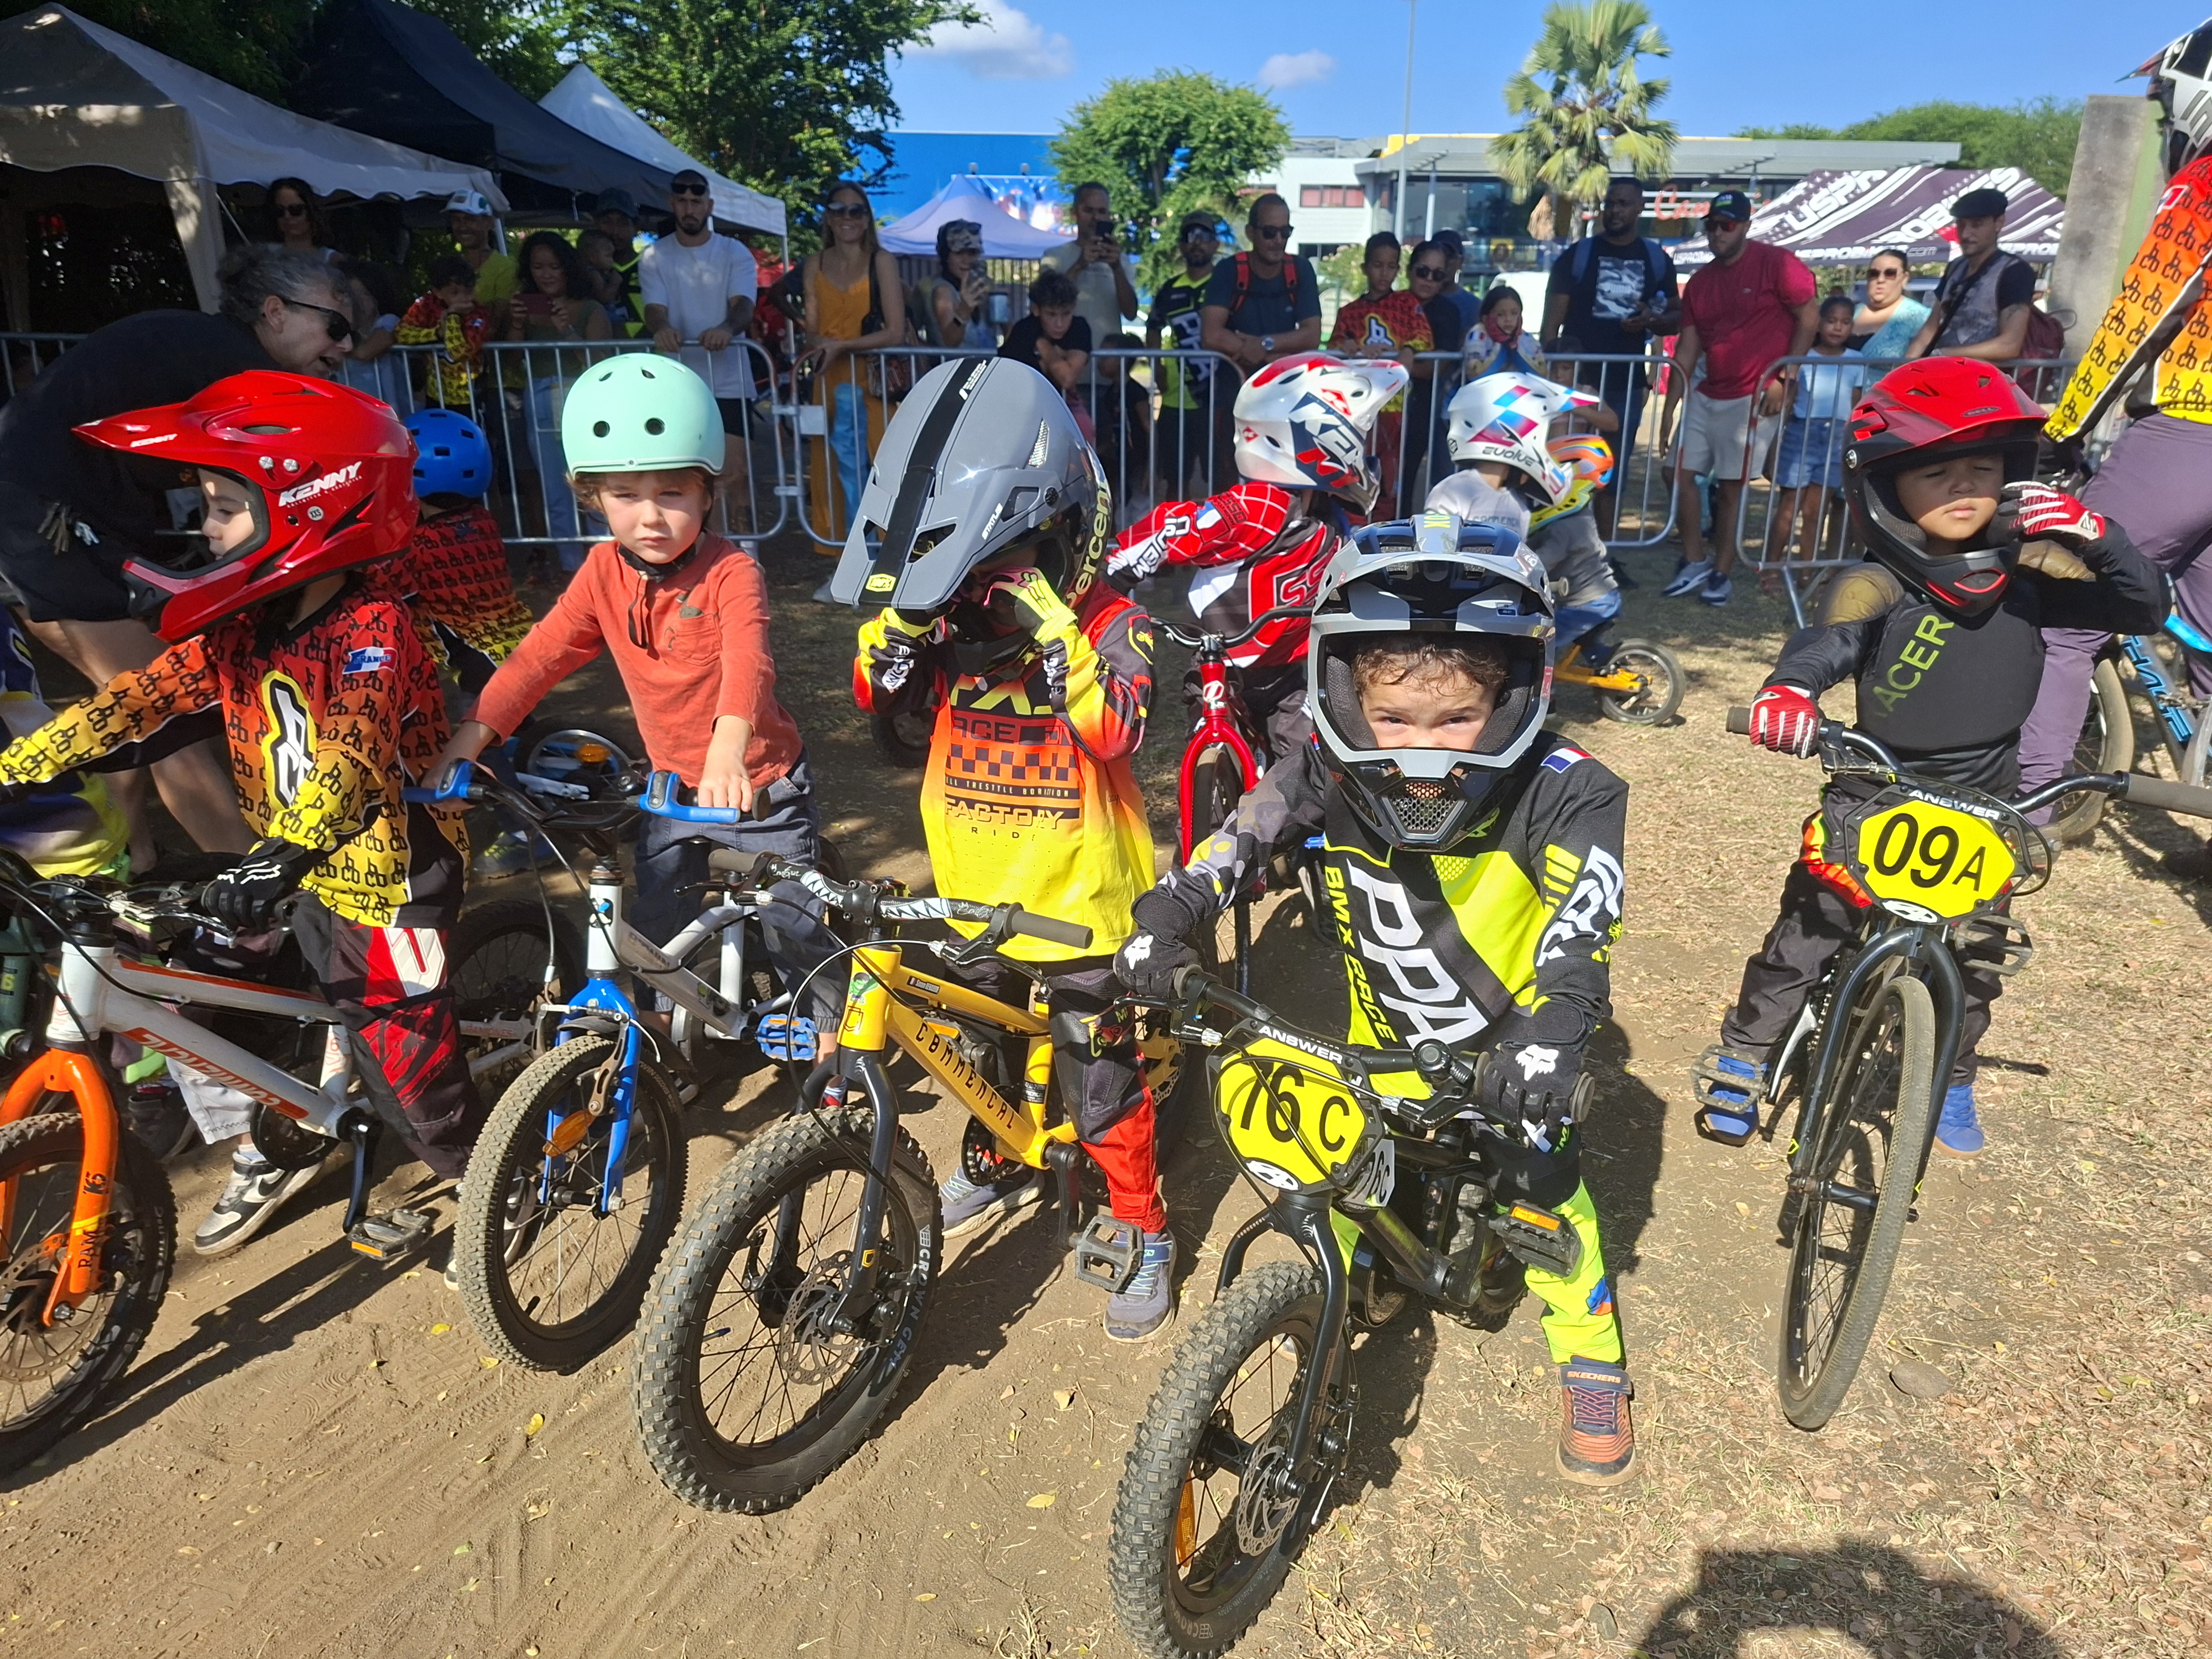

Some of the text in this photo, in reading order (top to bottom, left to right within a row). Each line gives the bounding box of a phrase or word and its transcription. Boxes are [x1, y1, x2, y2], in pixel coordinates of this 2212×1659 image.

[278, 461, 362, 507] KENNY
[981, 503, 1003, 540] STATUS
[354, 654, 392, 665] FRANCE
[1872, 614, 1955, 717] ACER
[1909, 789, 2000, 820] ANSWER
[1325, 865, 1398, 1042] BMX RACE
[1258, 1025, 1344, 1065] ANSWER
[915, 1022, 1016, 1130] COMMENCAL
[910, 1249, 931, 1321] CROWN
[1566, 1371, 1621, 1384] SKECHERS
